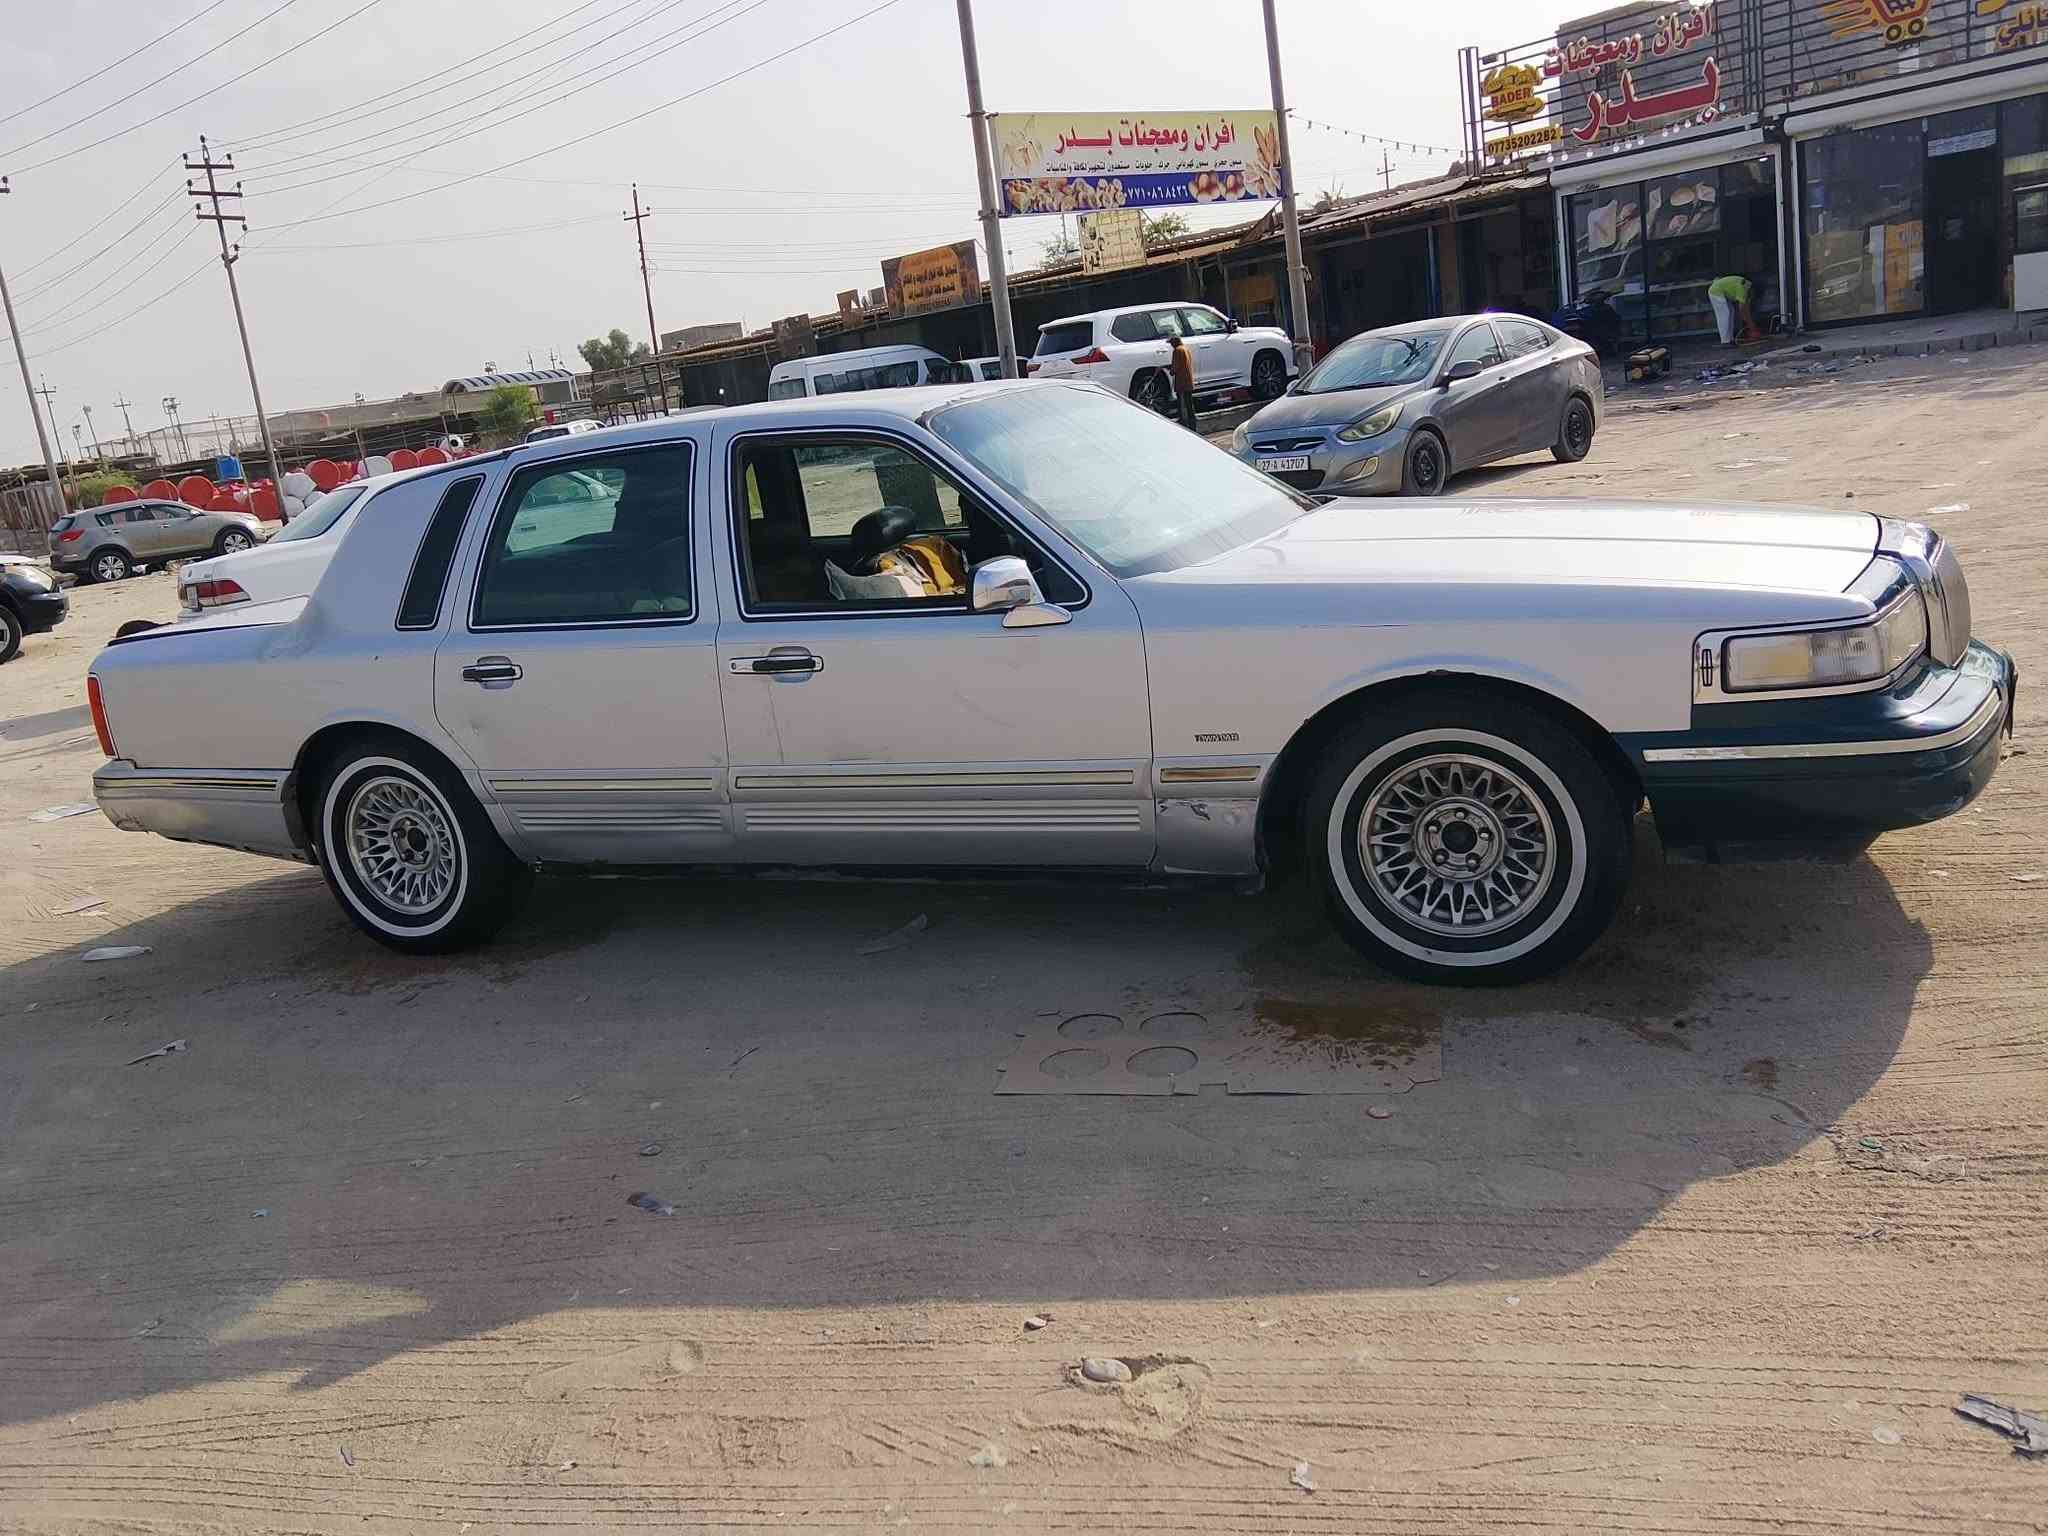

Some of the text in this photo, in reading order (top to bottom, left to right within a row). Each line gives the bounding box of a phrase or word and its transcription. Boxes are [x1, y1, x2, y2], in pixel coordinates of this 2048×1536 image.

[1542, 5, 1716, 77] افران ومعجنات
[1490, 86, 1532, 109] BADER
[1571, 56, 1720, 141] بدر
[1054, 118, 1236, 155] افران ومعجنات بدر
